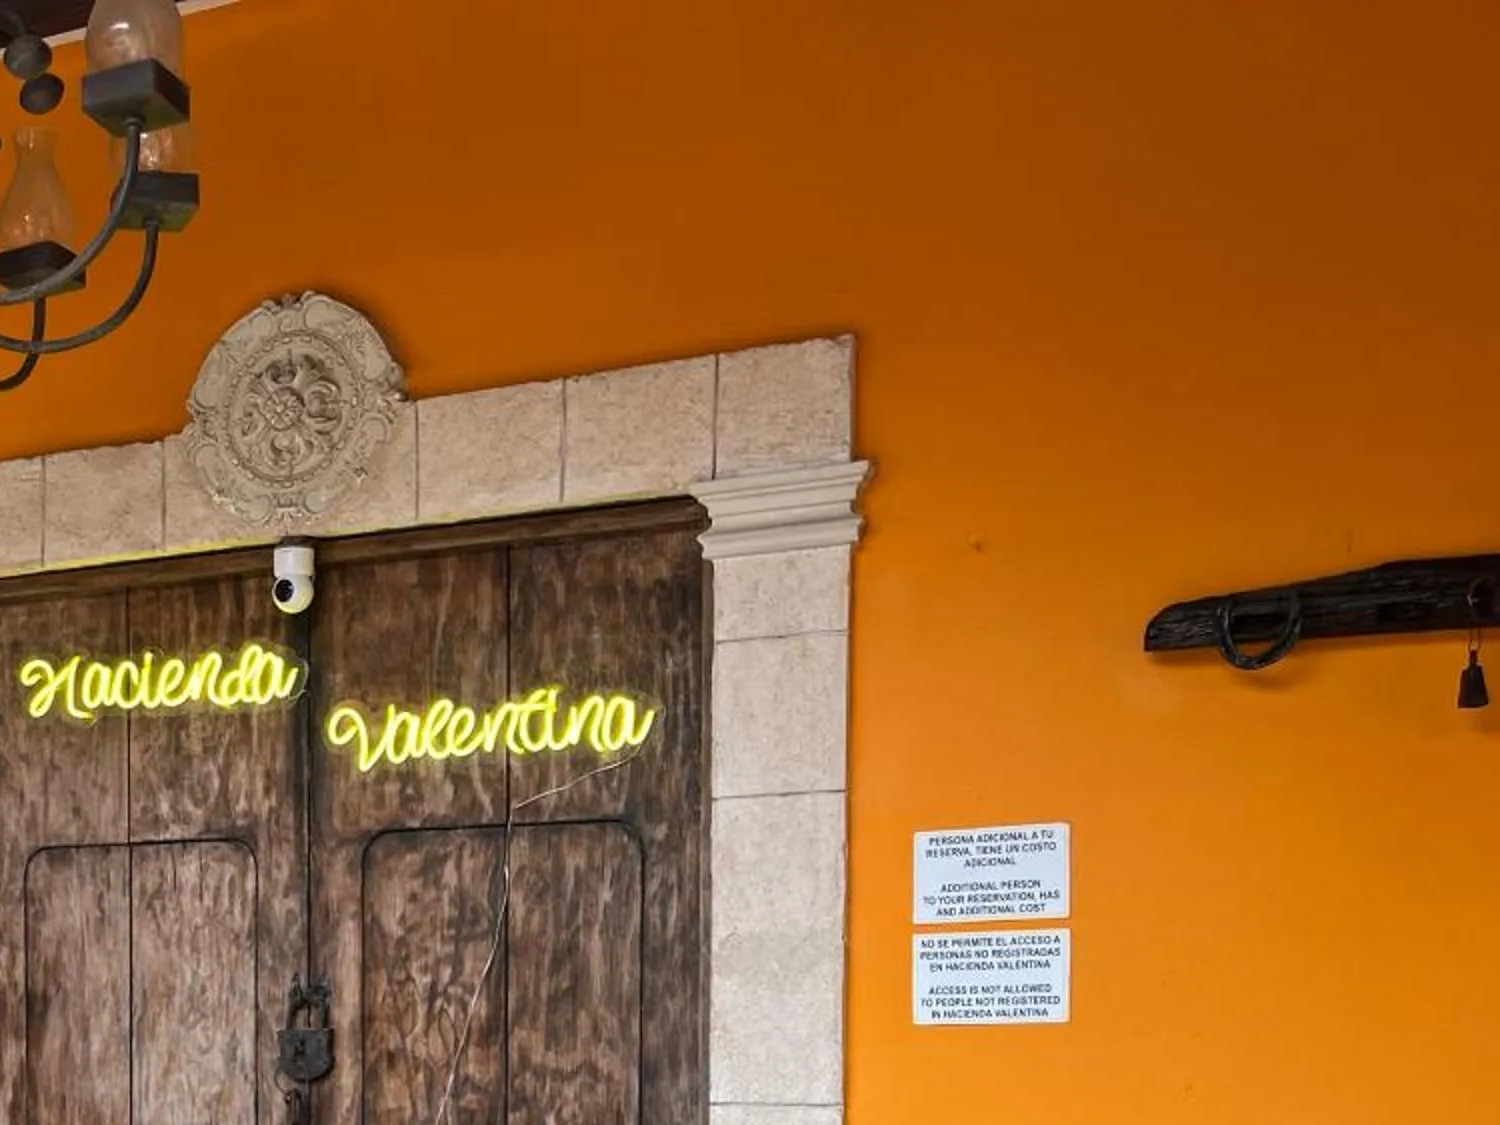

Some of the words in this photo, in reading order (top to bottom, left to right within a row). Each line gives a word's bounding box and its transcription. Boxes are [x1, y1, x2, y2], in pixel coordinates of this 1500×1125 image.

[20, 644, 301, 719] Hacienda
[327, 687, 655, 772] Valentina
[929, 835, 974, 845] PERSONA
[976, 832, 1028, 843] ADICIONAL
[1041, 830, 1053, 838] TU
[976, 845, 1002, 854] TIENE
[1006, 844, 1020, 852] UN
[1022, 842, 1056, 852] COSTO
[964, 857, 1016, 867] ADICIONAL
[941, 883, 998, 892] ADDITIONAL
[1001, 880, 1040, 889] PERSON
[938, 895, 964, 904] YOUR
[1040, 890, 1060, 898] HAS
[959, 905, 1015, 915] ADDITIONAL
[1019, 904, 1046, 912] COST
[921, 940, 935, 948] NO
[951, 937, 993, 947] PERMITE
[996, 938, 1007, 946] EL
[1010, 936, 1051, 945] ACCESO
[920, 949, 972, 960] PERSONAS
[975, 950, 988, 958] NO
[992, 947, 1060, 958] REGISTRADAS
[930, 963, 942, 972] EN
[945, 962, 994, 971] HACIENDA
[998, 960, 1051, 969] VALENTINA
[928, 985, 966, 995] ACCESS
[970, 985, 978, 994] IS
[981, 985, 1001, 994] NOT
[1004, 984, 1052, 993] ALLOWED
[921, 999, 932, 1007] TO
[935, 997, 972, 1006] PEOPLE
[976, 997, 995, 1006] NOT
[998, 995, 1060, 1005] REGISTERED
[932, 1010, 941, 1018] IN
[943, 1009, 992, 1019] HACIENDA
[995, 1008, 1049, 1017] VALENTINA
